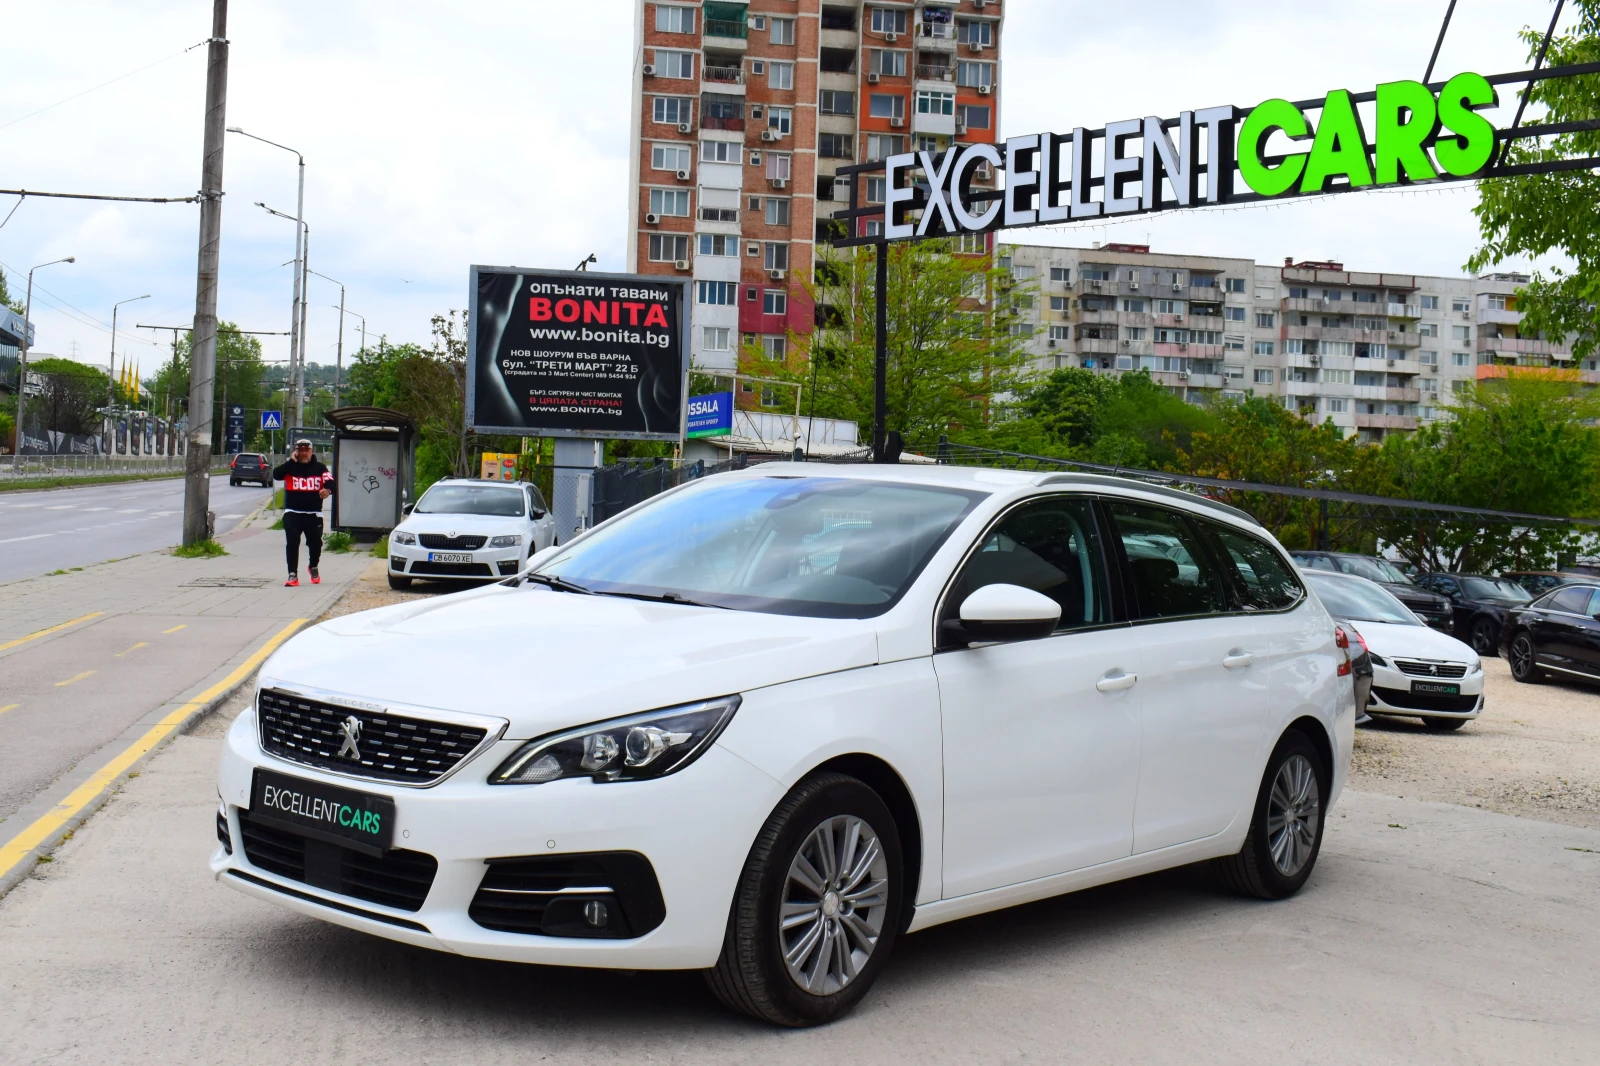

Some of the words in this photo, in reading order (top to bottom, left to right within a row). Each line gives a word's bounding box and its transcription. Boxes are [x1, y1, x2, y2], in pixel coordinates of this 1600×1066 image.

[885, 72, 1495, 240] EXCELLENTCARS
[530, 283, 605, 297] опънати
[610, 287, 669, 301] тавани
[529, 297, 669, 328] BONITA
[529, 327, 670, 348] www.bonita.bg
[510, 349, 531, 357] НОВ
[533, 350, 574, 359] ШОУРУМ
[576, 351, 598, 360] ВЪВ
[599, 353, 631, 361] ВАРНА
[502, 359, 526, 369] бул.
[615, 364, 628, 372] 22
[630, 364, 639, 373] Б
[569, 371, 594, 379] Center)
[539, 397, 578, 406] ЦЯЛАТА
[580, 398, 623, 407] СТРАНА!
[529, 405, 623, 416] www.BONITA.bg
[292, 476, 322, 491] GCDS
[443, 554, 461, 562] 6070
[263, 784, 381, 835] EXCELLENTCARS
